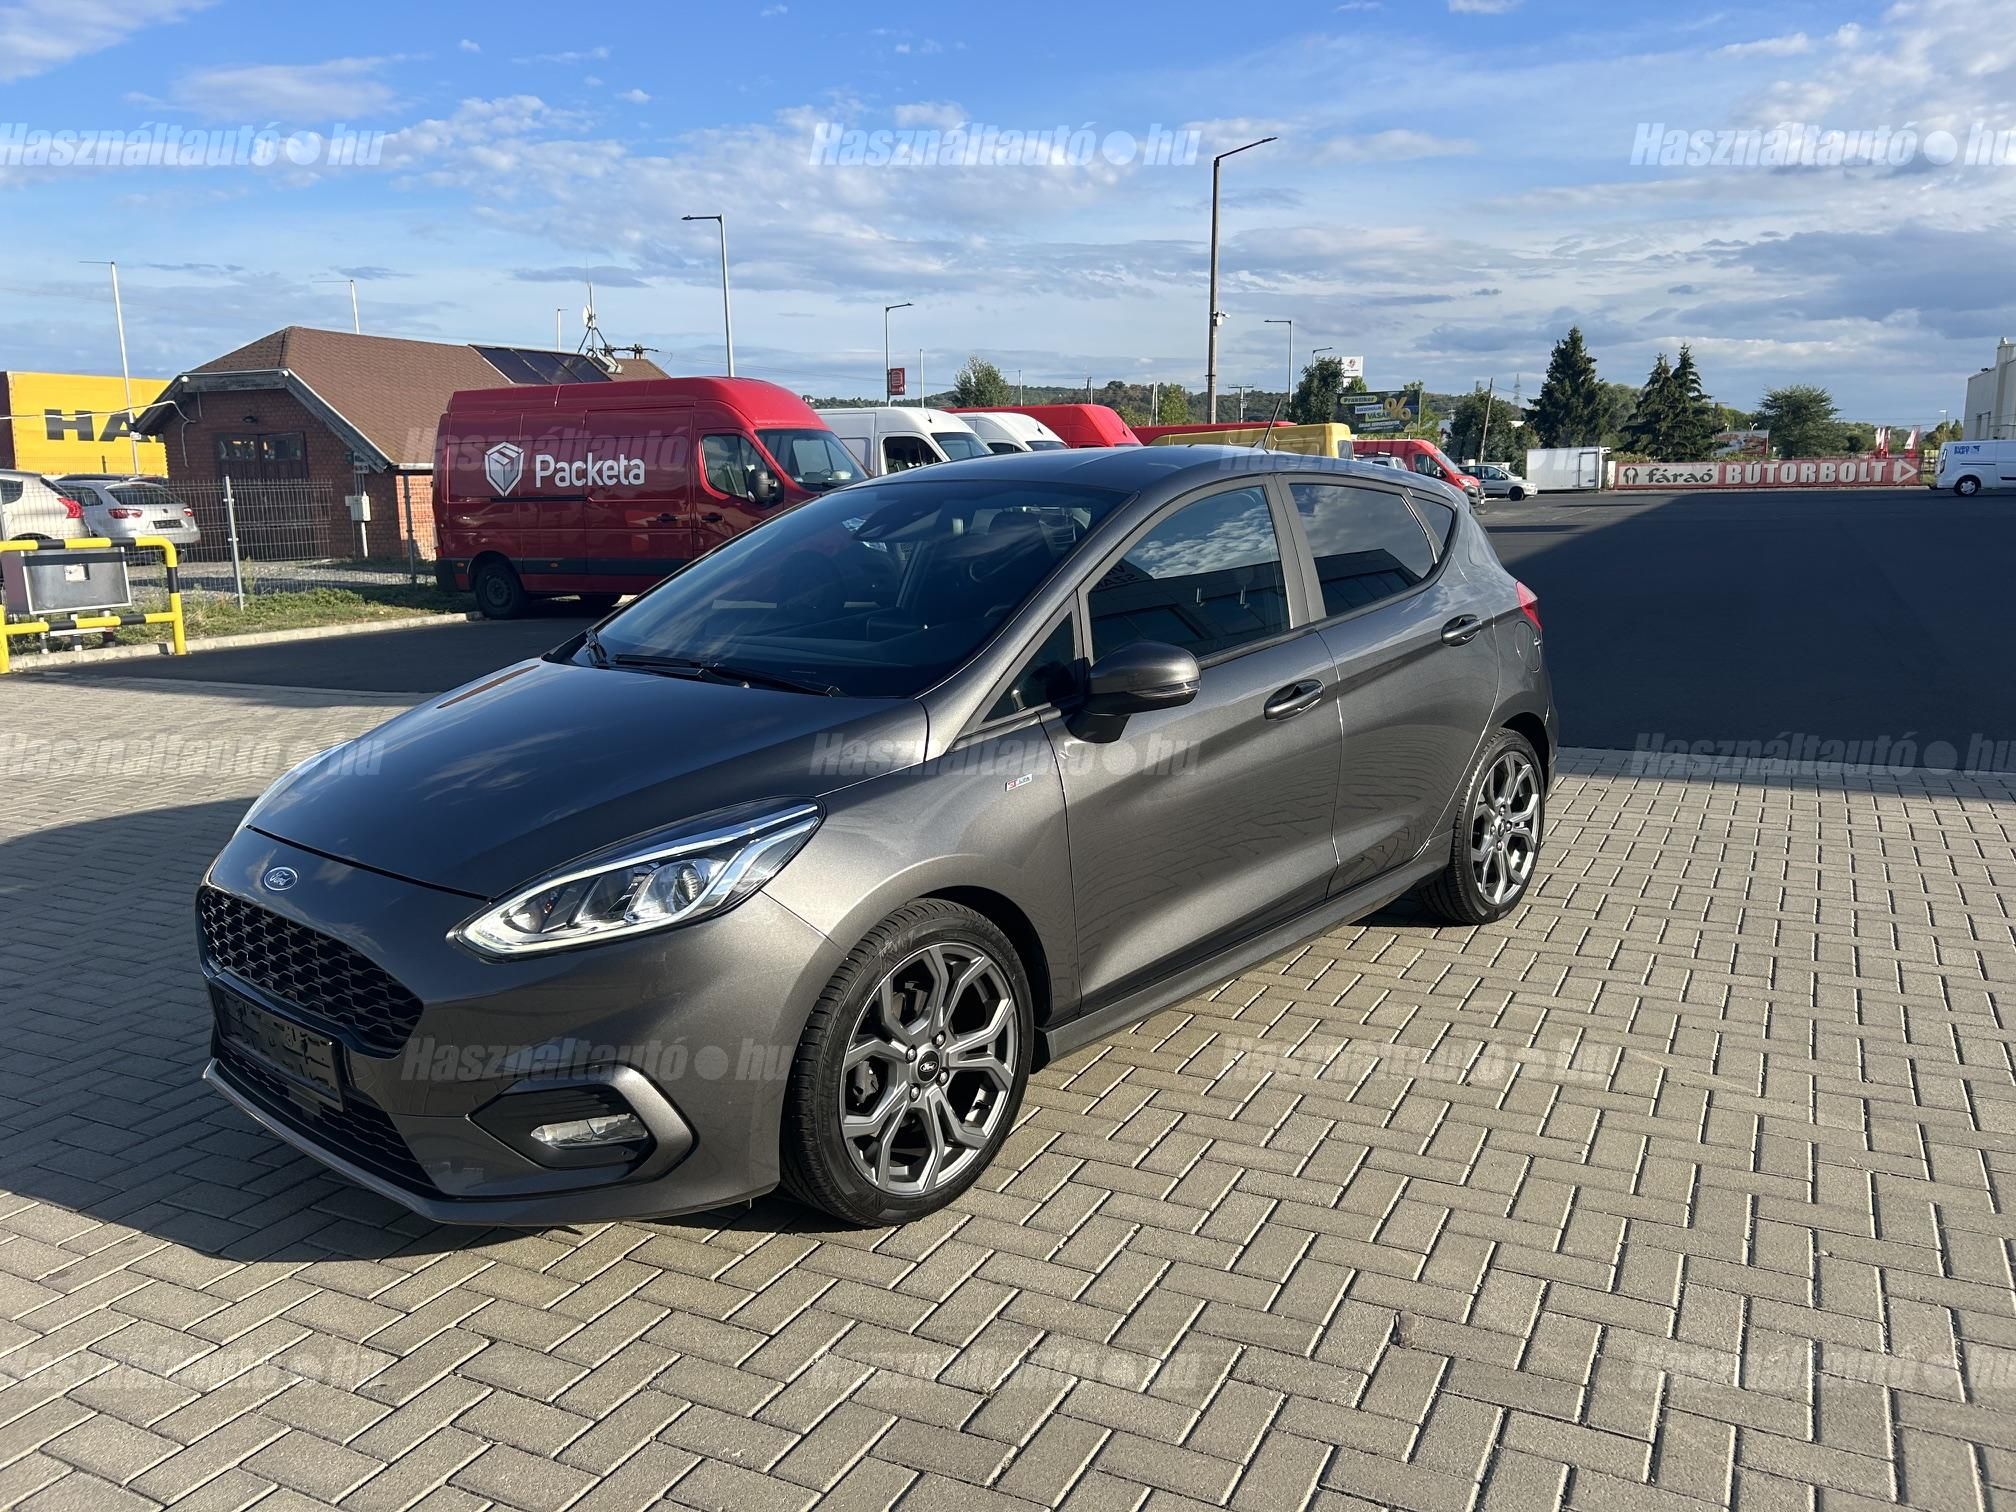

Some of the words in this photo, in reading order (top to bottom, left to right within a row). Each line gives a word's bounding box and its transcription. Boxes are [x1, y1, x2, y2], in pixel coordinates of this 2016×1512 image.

[535, 452, 645, 488] Packeta
[1645, 468, 1714, 483] fáraó
[1725, 461, 1888, 485] BÚTORBOLT
